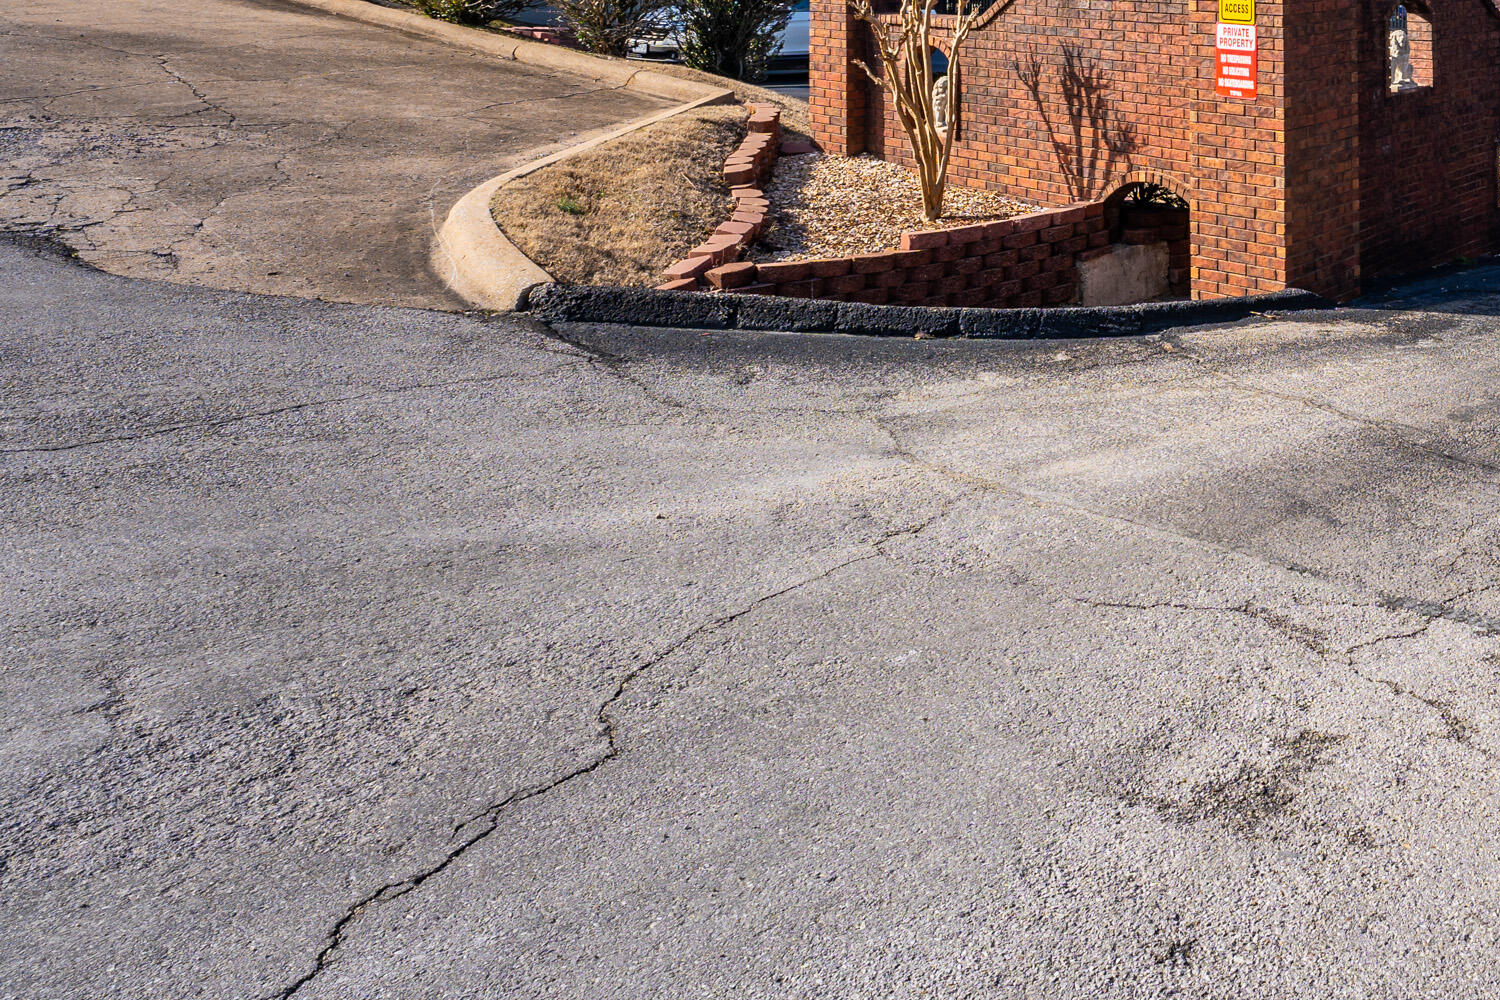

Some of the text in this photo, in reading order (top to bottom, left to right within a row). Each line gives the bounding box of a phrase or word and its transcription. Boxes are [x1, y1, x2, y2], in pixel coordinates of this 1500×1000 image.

[1224, 3, 1249, 14] ACCESS
[1223, 27, 1249, 38] PRIVATE
[1219, 37, 1254, 48] PROPERTY
